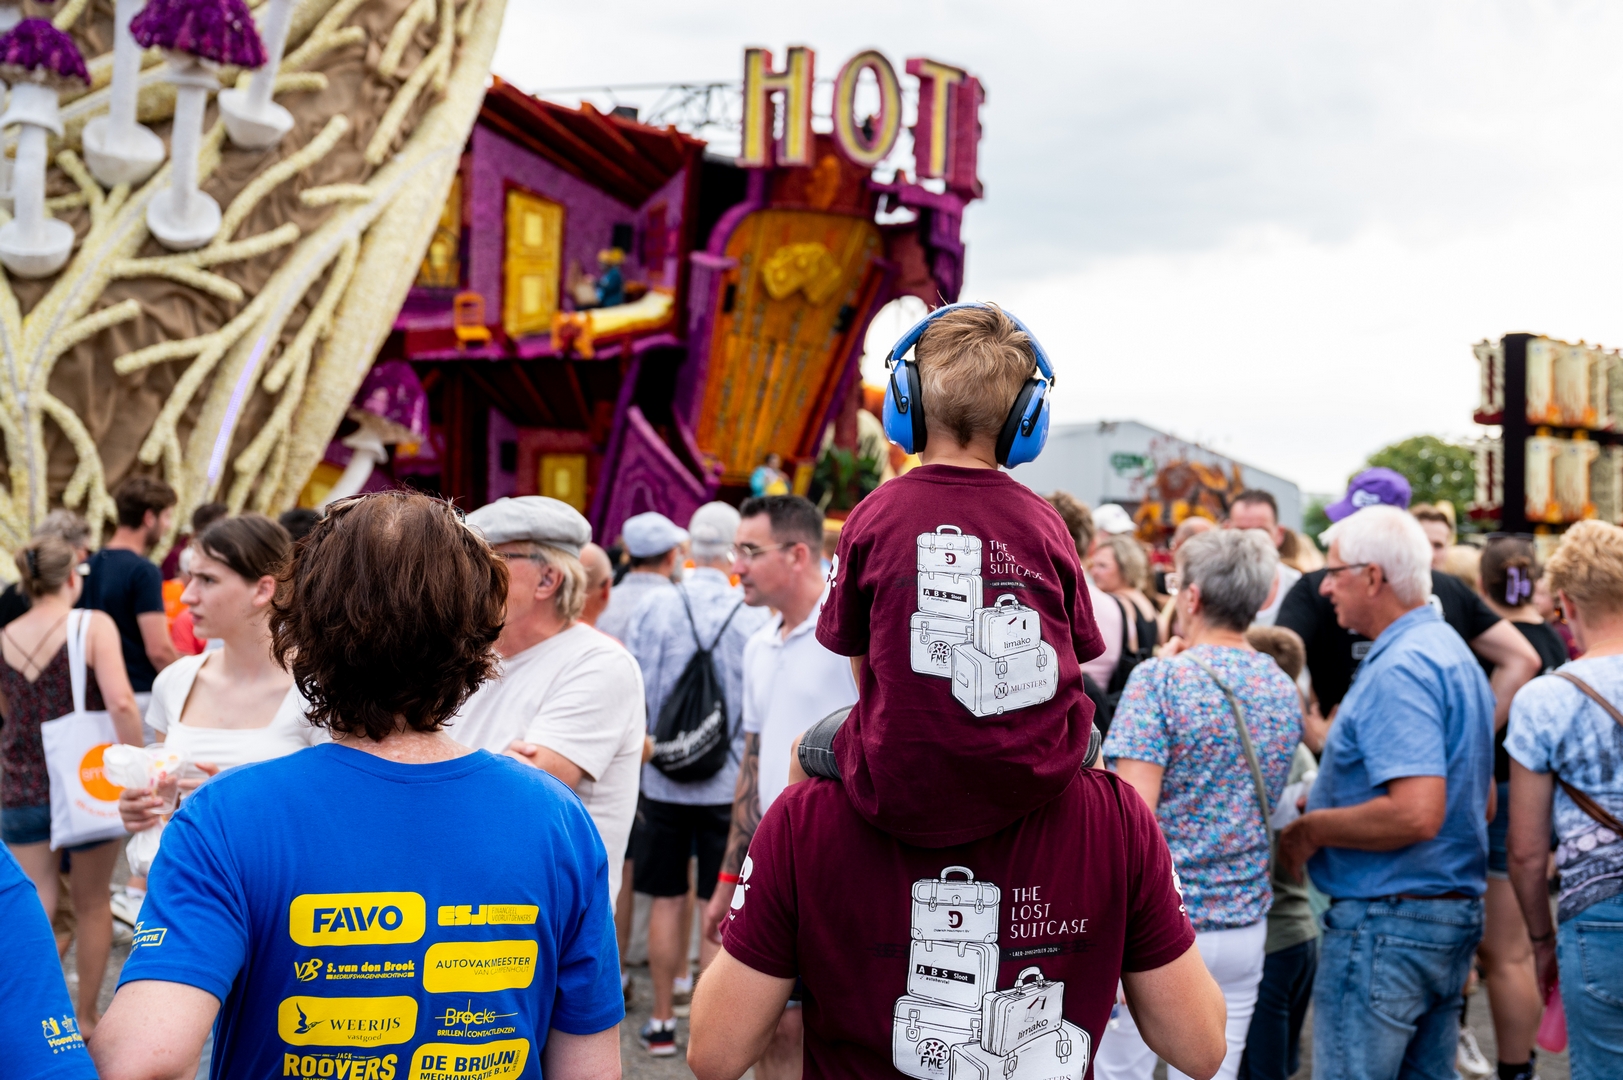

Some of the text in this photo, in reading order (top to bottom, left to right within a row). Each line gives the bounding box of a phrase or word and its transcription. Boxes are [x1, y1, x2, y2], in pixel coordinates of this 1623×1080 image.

[989, 539, 1008, 551] THE
[990, 552, 1017, 563] LOST
[990, 563, 1045, 581] SUITCASE
[1003, 637, 1031, 649] limako
[930, 653, 948, 664] FME
[1010, 679, 1048, 692] MUTSTERS
[1012, 886, 1041, 903] THE
[312, 905, 404, 933] FAVO
[438, 905, 487, 926] ESJ
[1011, 903, 1051, 921] LOST
[1010, 918, 1089, 939] SUITCASE
[327, 962, 337, 973] S.
[338, 964, 358, 973] van
[361, 961, 381, 972] den
[384, 959, 415, 972] Broek
[435, 956, 531, 969] AUTOVAKMEESTER
[953, 972, 968, 981] Sloot
[330, 1016, 401, 1032] WEERIJS
[444, 1008, 496, 1027] Brocks
[437, 1027, 516, 1038] BRILLEN CONTACTLENZEN
[1018, 1018, 1049, 1040] limako
[347, 1033, 382, 1042] vastgoed
[283, 1053, 398, 1080] ROOVERS
[421, 1050, 516, 1072] DE BRUIJN
[920, 1056, 945, 1070] FME
[420, 1070, 492, 1080] MECHANISATIE
